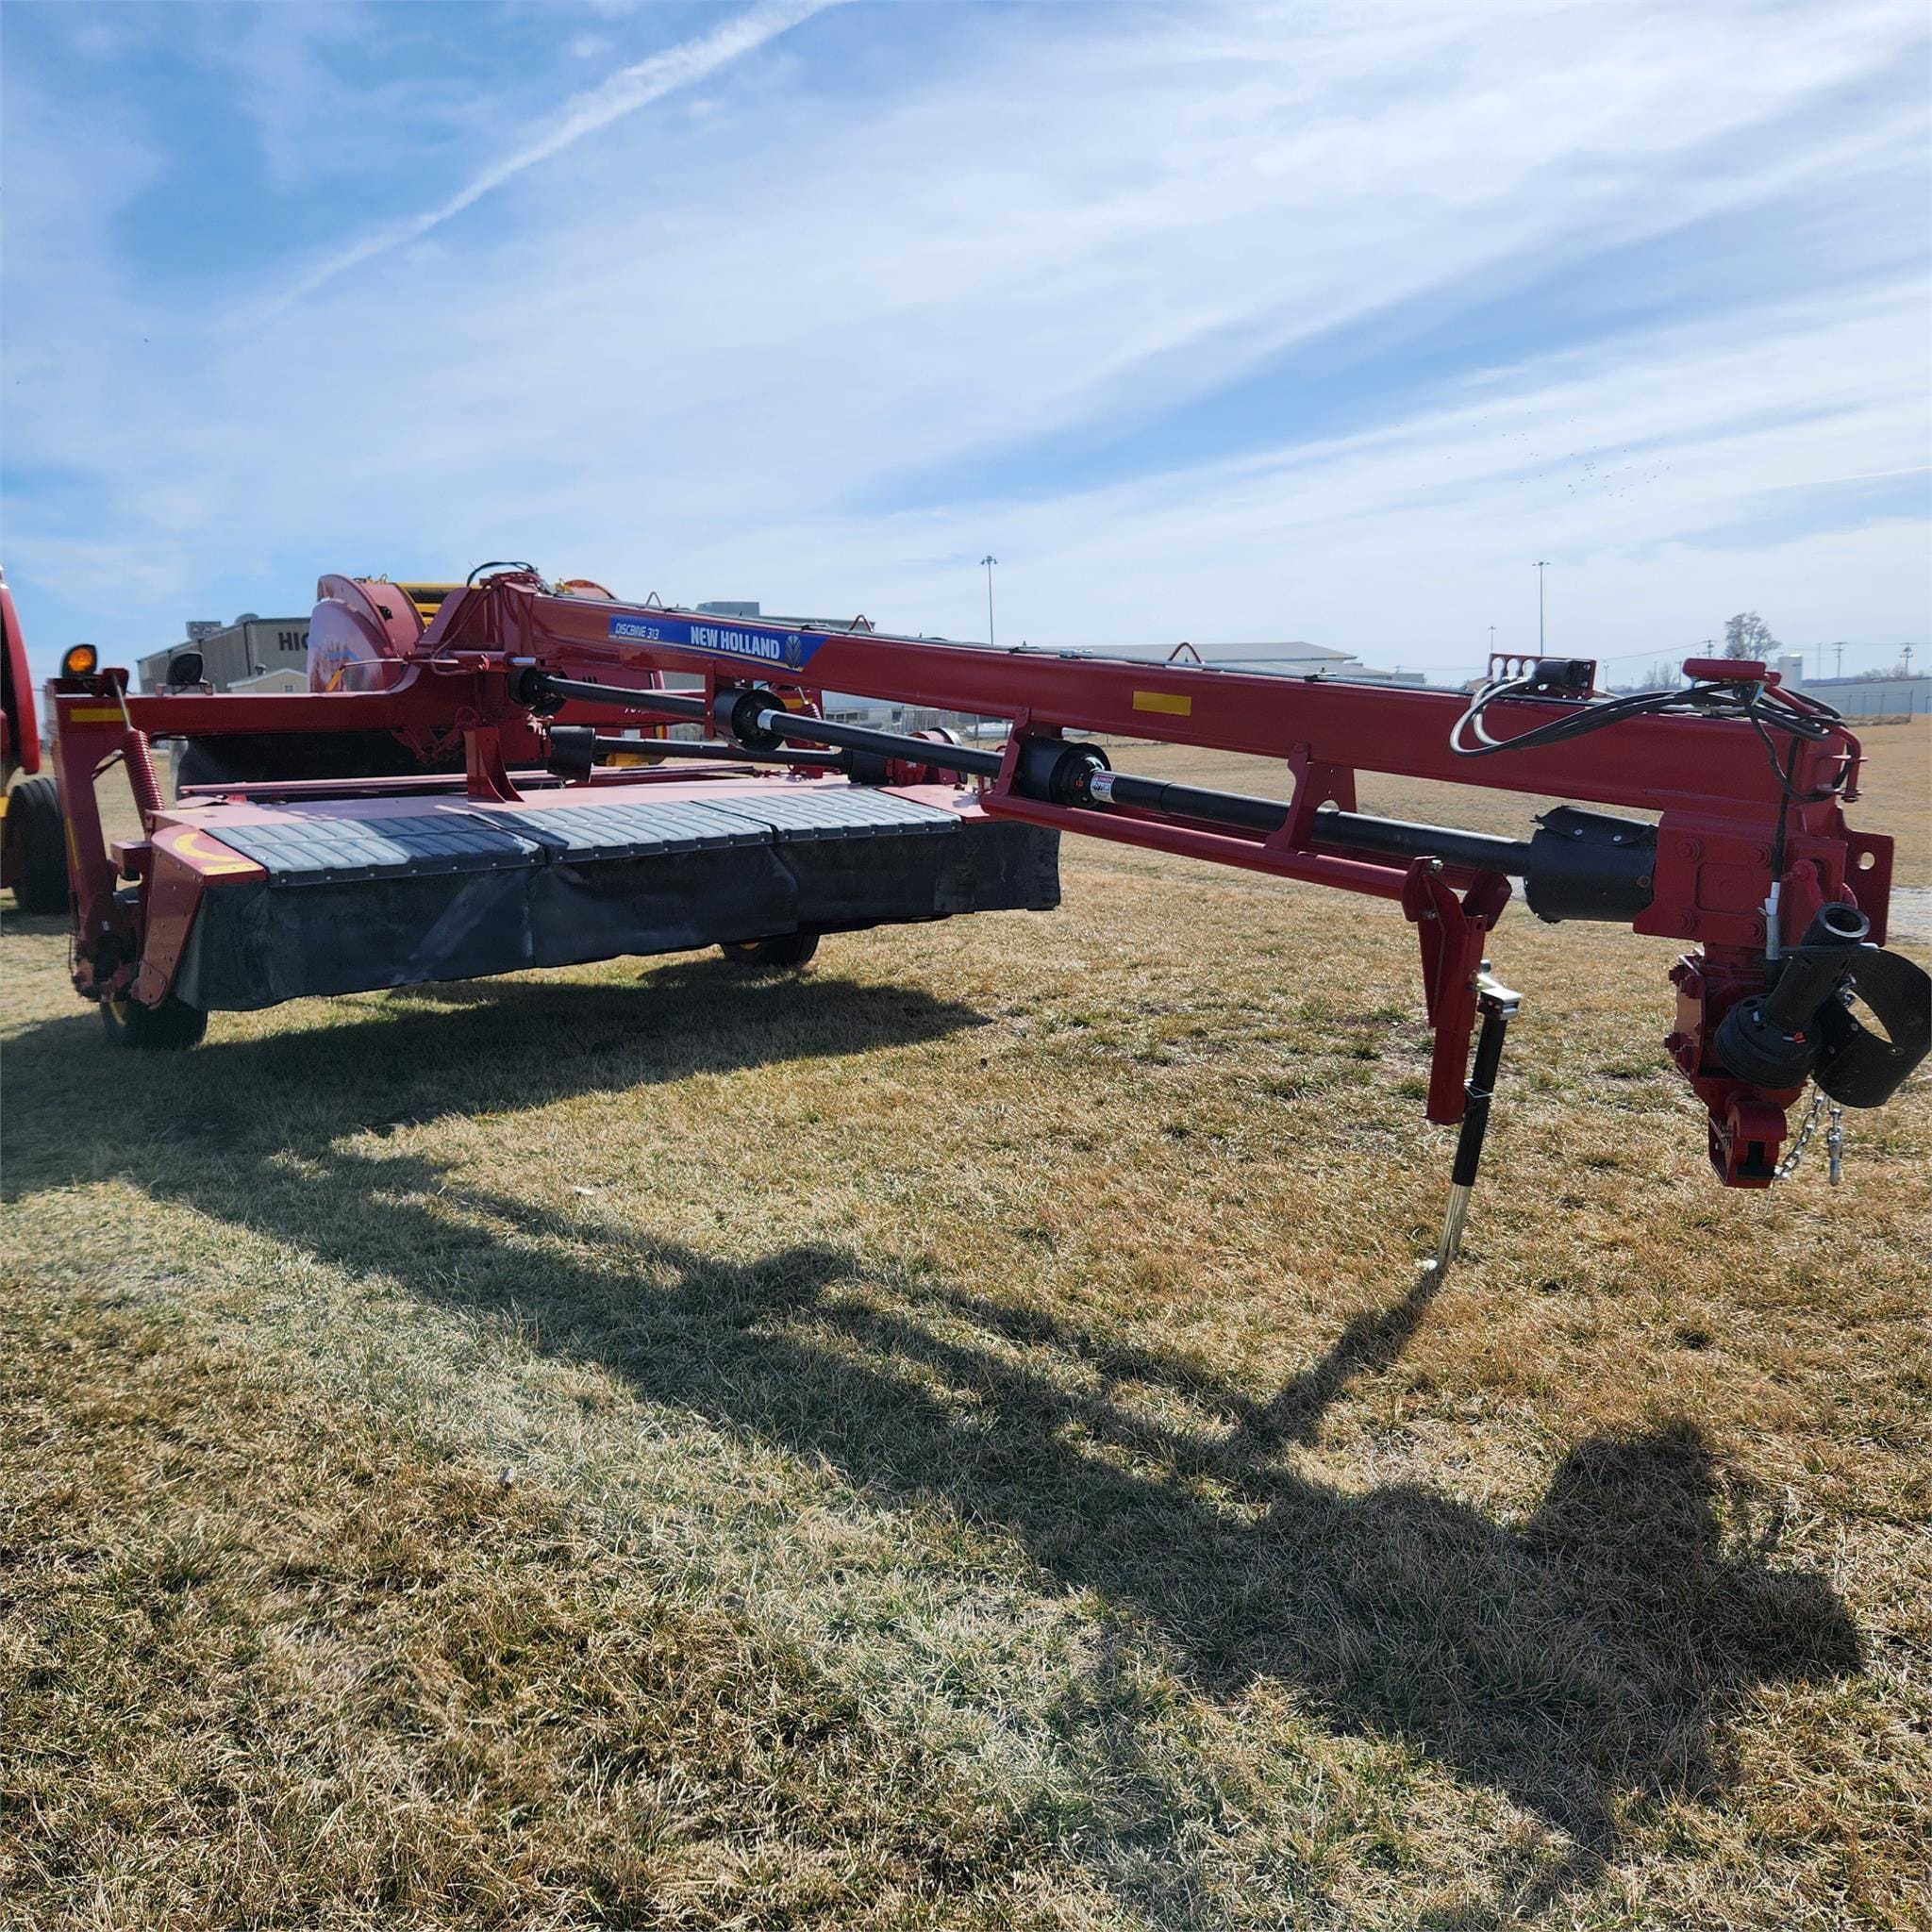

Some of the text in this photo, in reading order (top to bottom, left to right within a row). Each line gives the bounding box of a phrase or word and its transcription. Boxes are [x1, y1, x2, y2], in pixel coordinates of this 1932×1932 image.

[647, 626, 659, 640] 313
[691, 625, 780, 659] NEW HOLLAND
